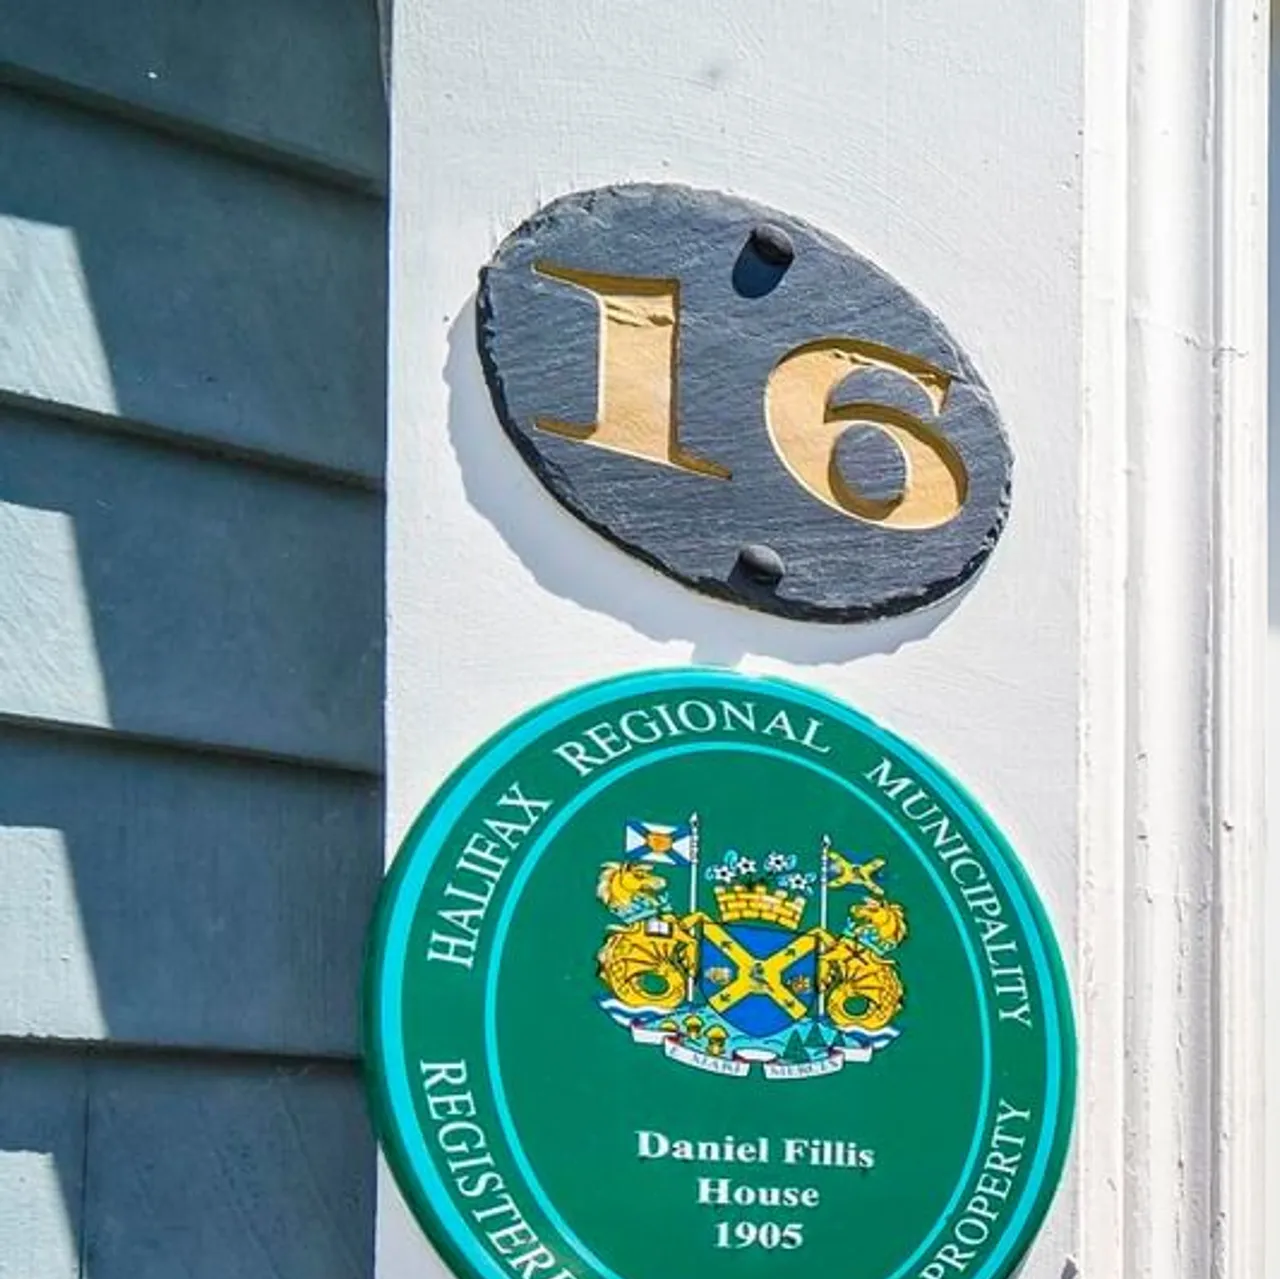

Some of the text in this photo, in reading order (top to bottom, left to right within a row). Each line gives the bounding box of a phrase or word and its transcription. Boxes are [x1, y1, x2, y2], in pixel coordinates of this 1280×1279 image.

[533, 259, 970, 531] 16
[428, 700, 1032, 1030] HALIFAX REGIONAL MUNICIPALITY
[637, 1131, 876, 1169] Daniel Fillis
[697, 1178, 820, 1208] House
[714, 1221, 804, 1250] 1905
